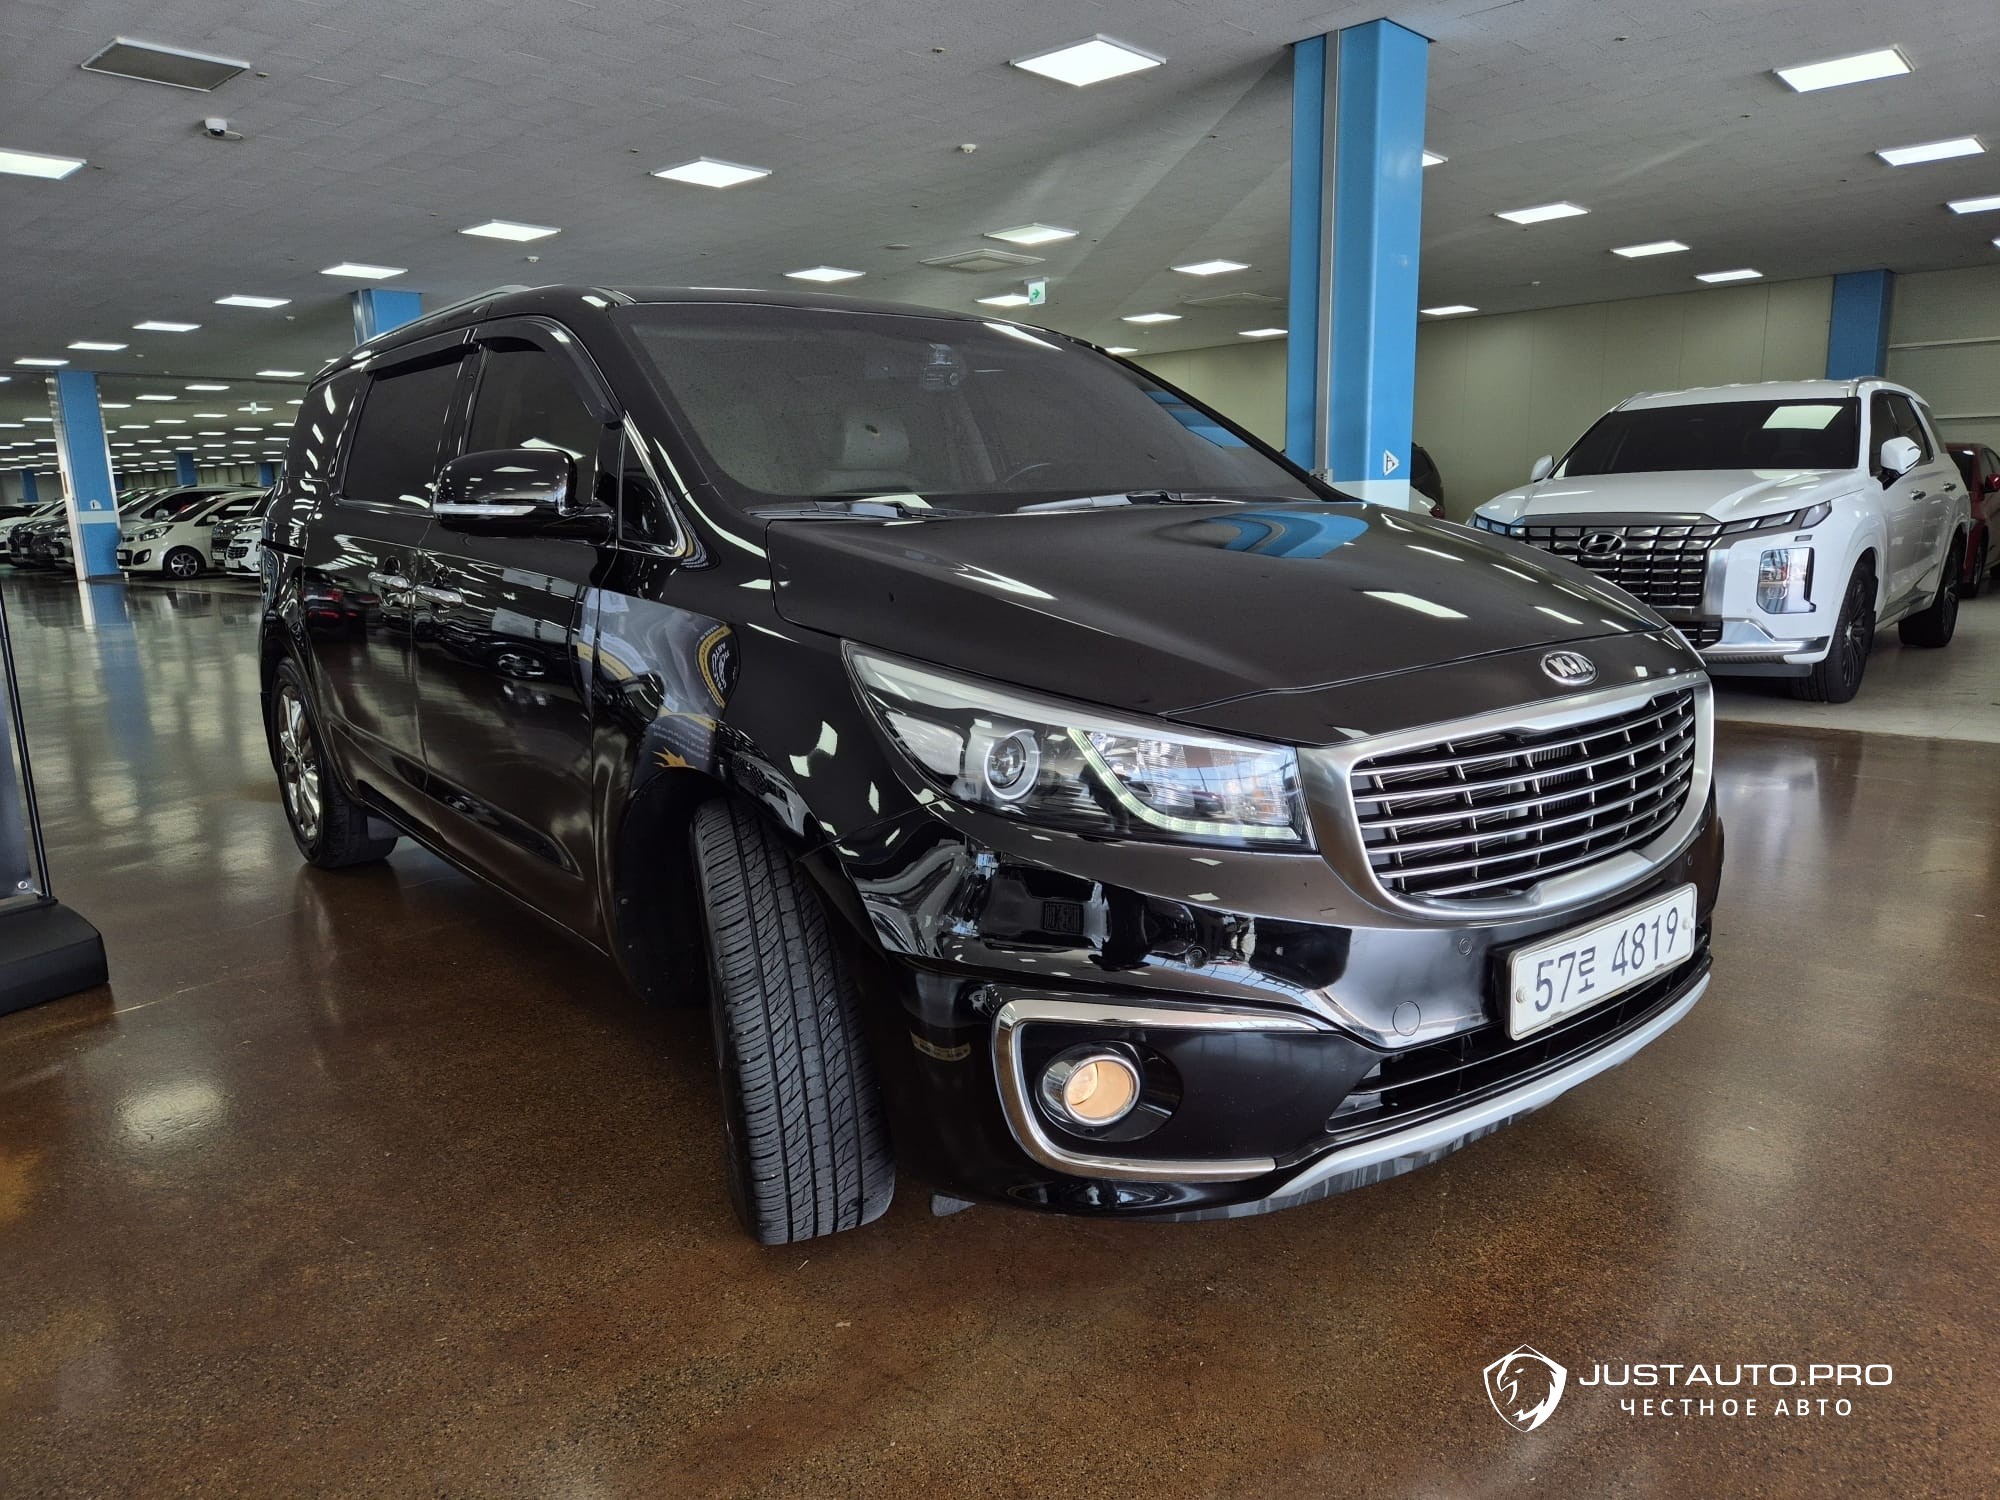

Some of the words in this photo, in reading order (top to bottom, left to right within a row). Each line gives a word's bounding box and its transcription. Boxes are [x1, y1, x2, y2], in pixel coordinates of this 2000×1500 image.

[1548, 654, 1593, 678] KIA
[1534, 945, 1597, 1012] 57로
[1611, 906, 1679, 977] 4819
